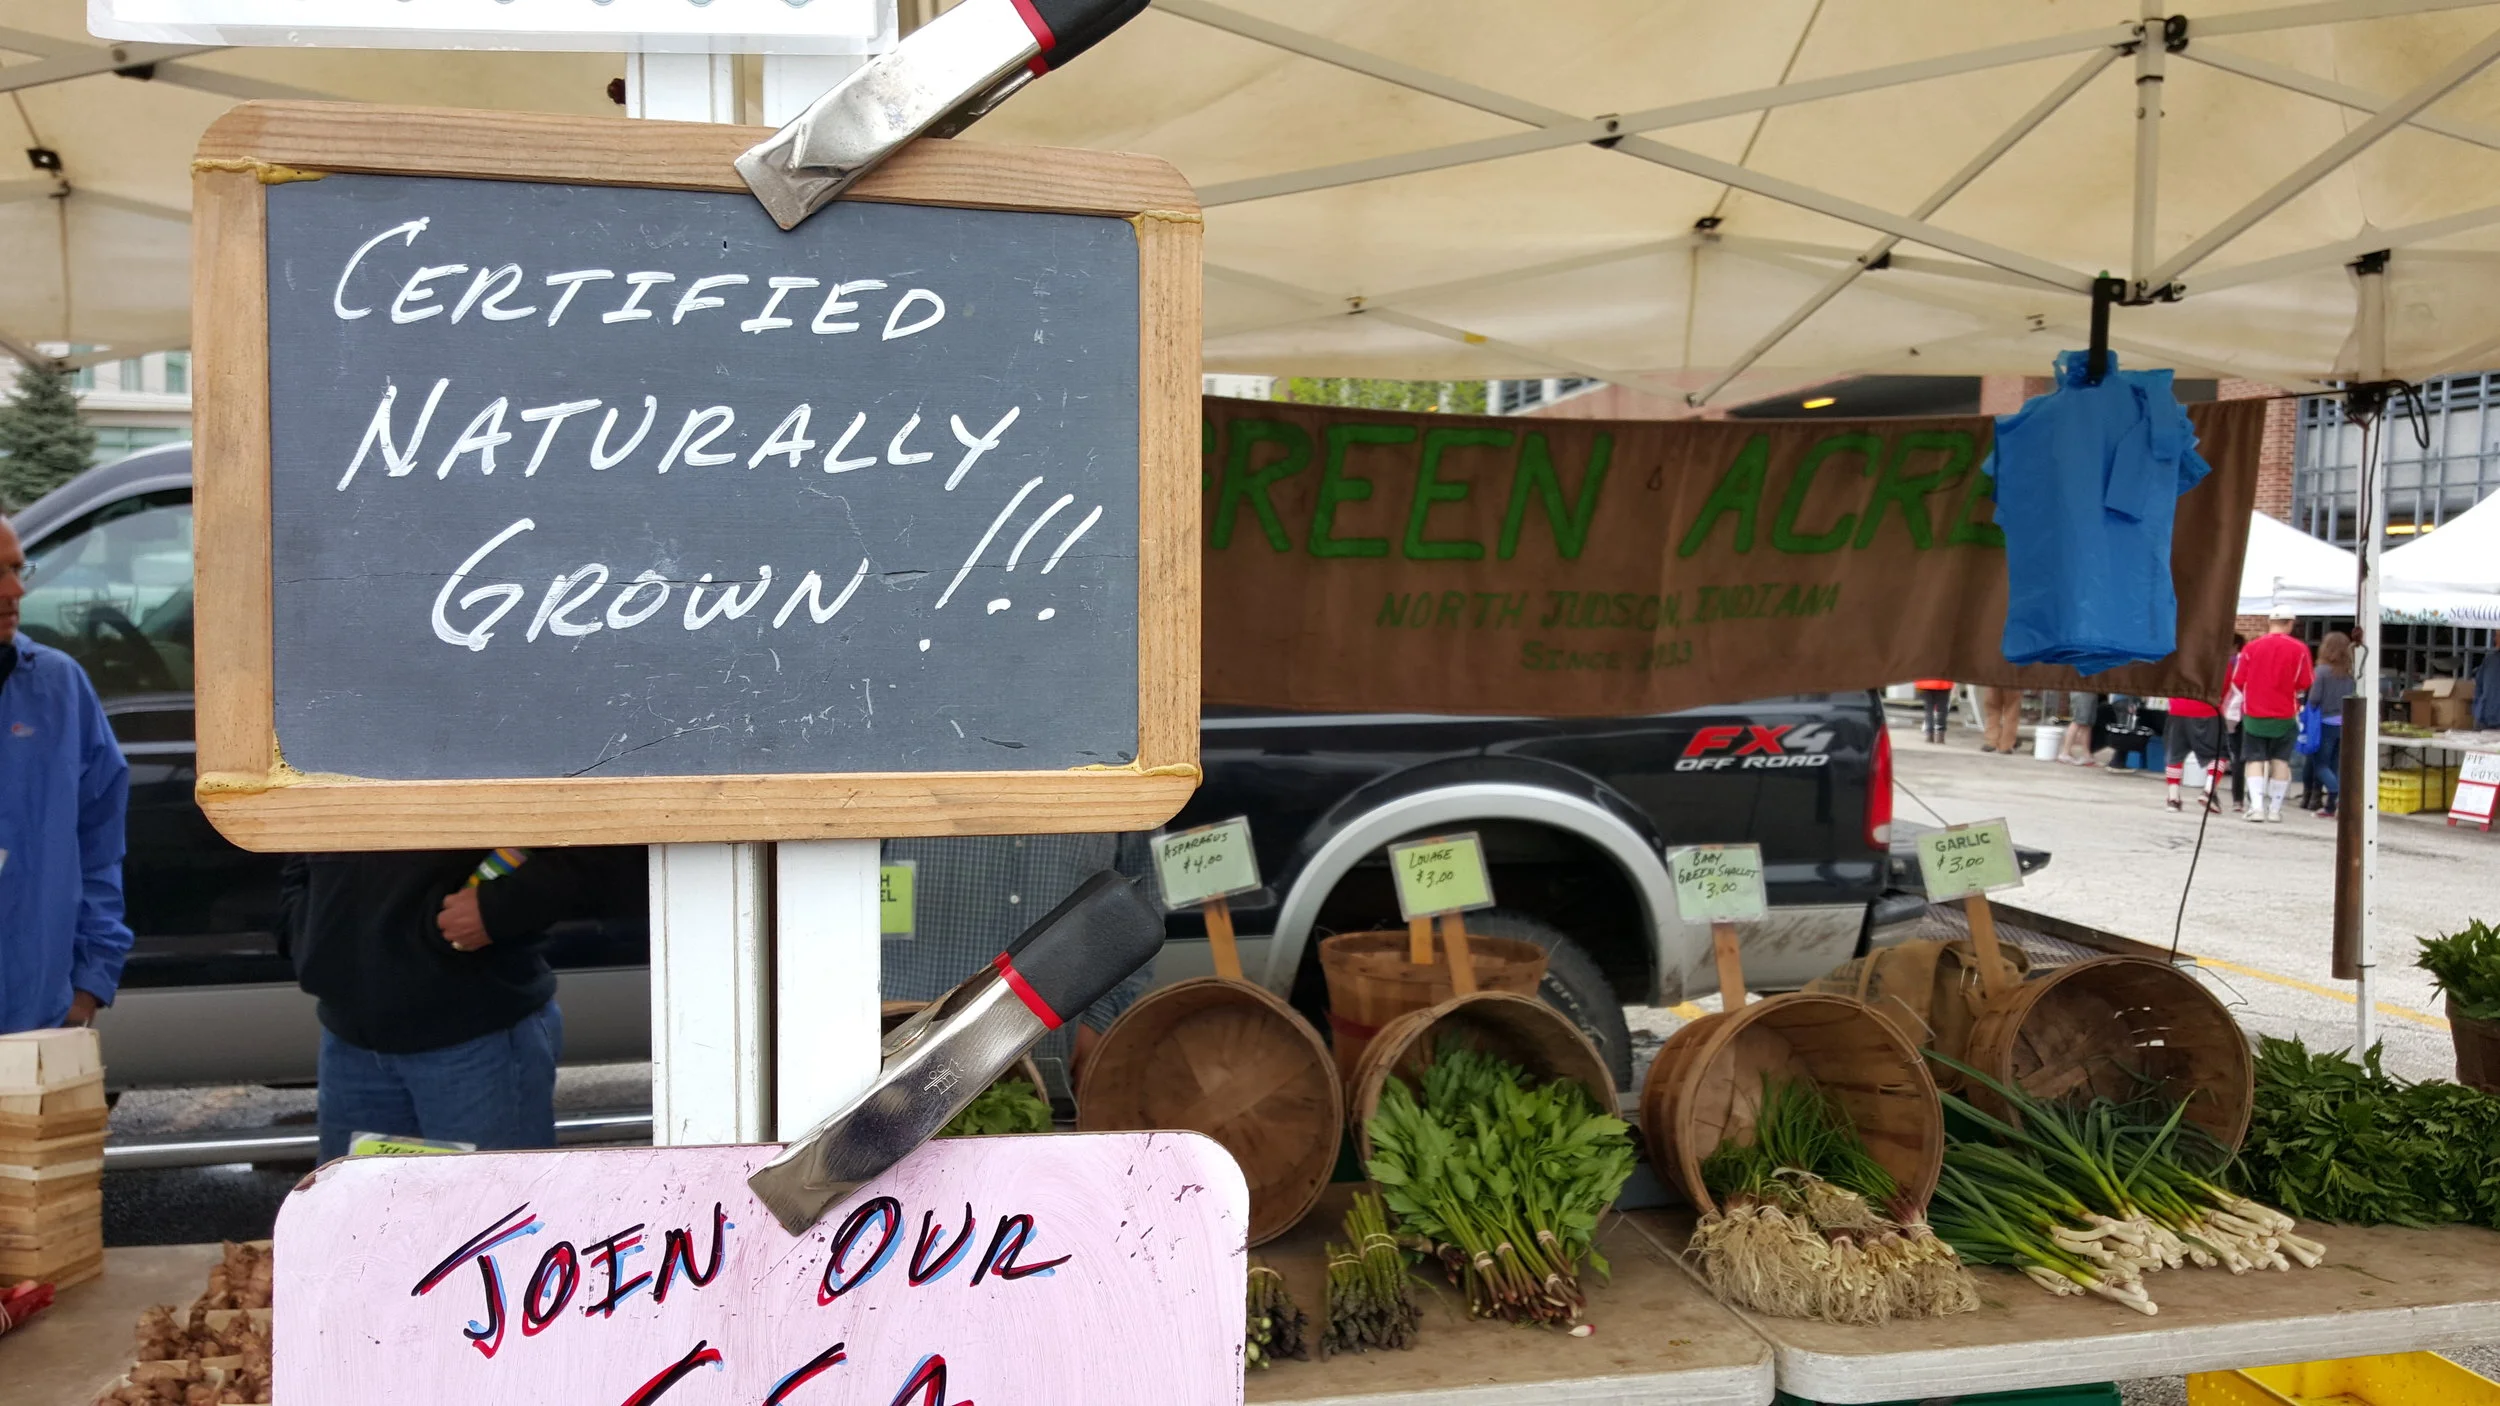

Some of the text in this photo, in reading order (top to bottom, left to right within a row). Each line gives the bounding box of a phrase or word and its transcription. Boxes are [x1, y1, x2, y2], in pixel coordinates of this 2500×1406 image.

[332, 214, 946, 342] CERTIFIED
[336, 376, 1021, 492] NATURALLY
[431, 517, 869, 652] GROWN
[1376, 591, 1528, 630] NORTH
[1691, 582, 1842, 626] INDIANA
[1677, 722, 1837, 758] FX4
[1674, 753, 1830, 772] OFF ROAD
[1163, 832, 1228, 861] ASPARAGUS
[1935, 832, 1991, 853] GARLIC
[1183, 855, 1223, 874] $4.00
[1678, 867, 1716, 885] GREEN
[1936, 853, 1985, 874] $3.00
[1416, 868, 1454, 889] $3.00
[411, 1196, 1073, 1359] JOIN OUR
